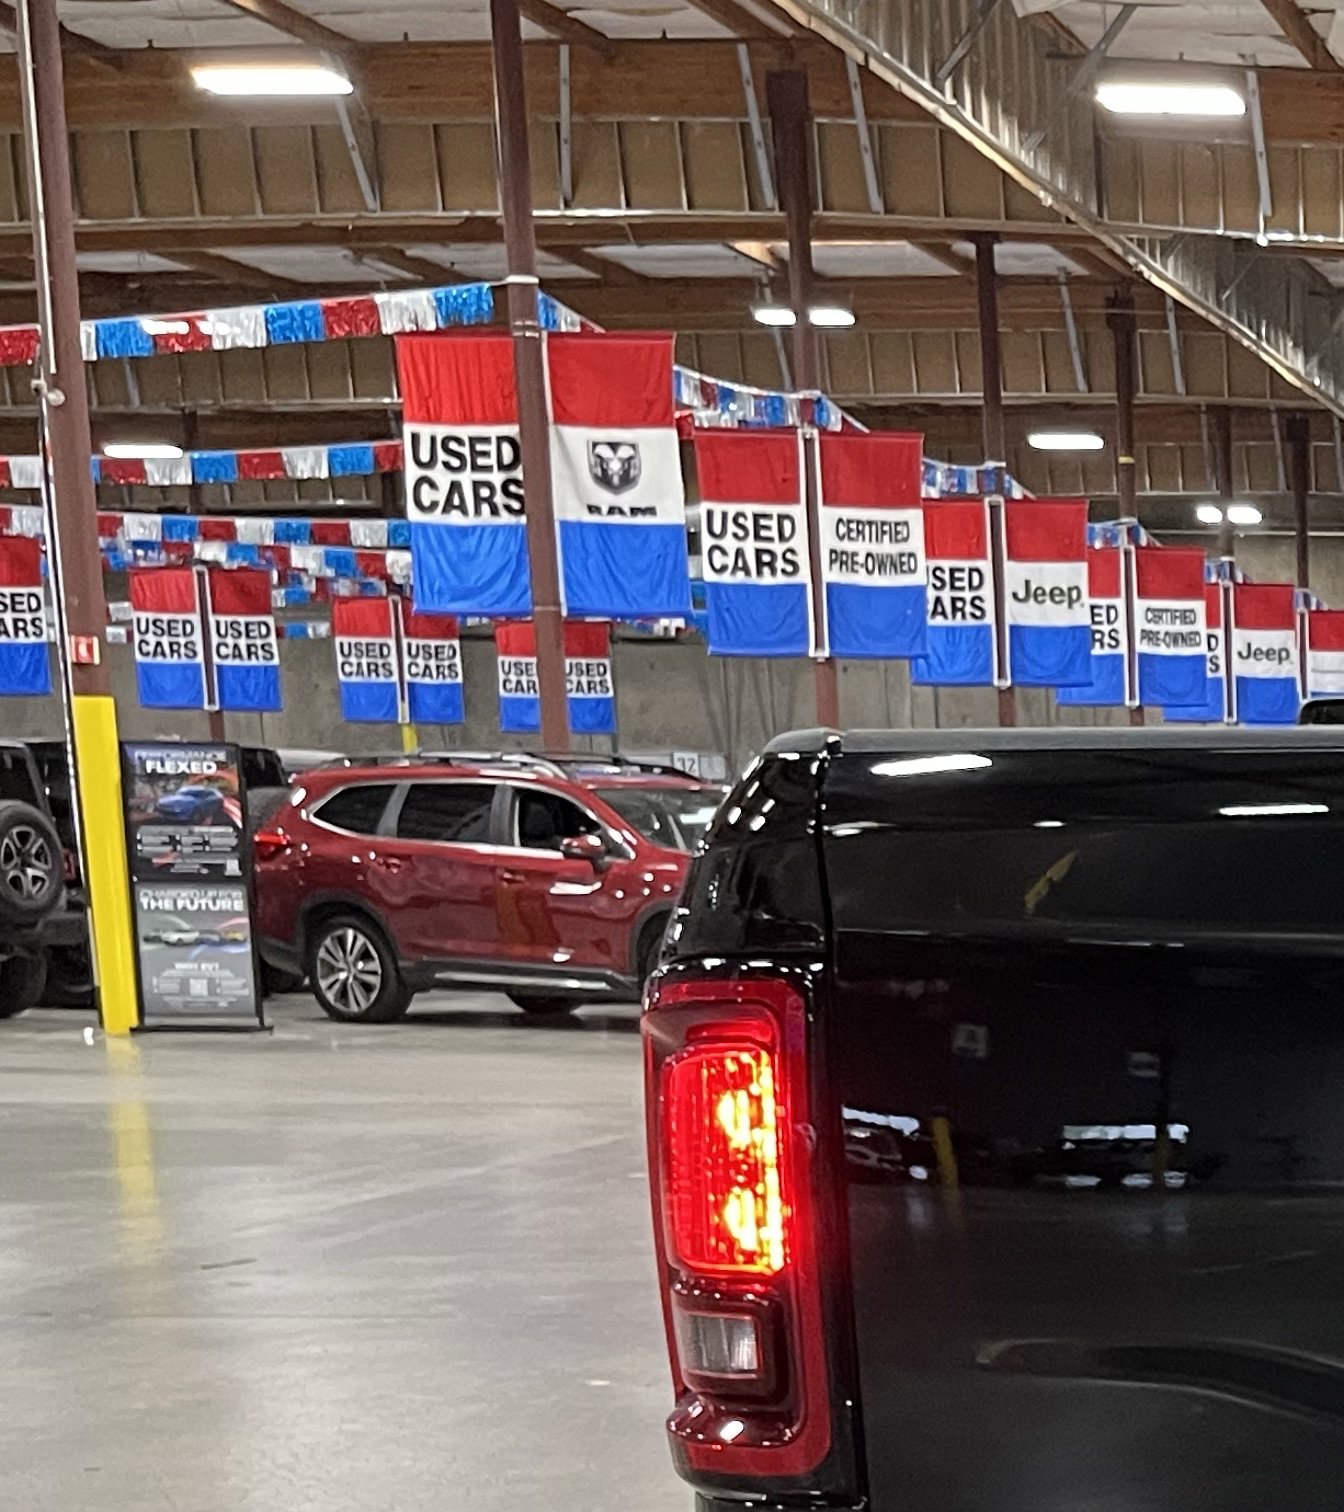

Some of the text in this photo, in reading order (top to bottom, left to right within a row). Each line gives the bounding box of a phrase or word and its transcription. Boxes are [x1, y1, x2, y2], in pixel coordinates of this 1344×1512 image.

[410, 432, 523, 474] USED
[412, 475, 526, 517] CARS
[586, 504, 658, 518] RAM
[706, 509, 797, 543] USED
[835, 518, 911, 544] CERTIFIED
[707, 545, 800, 578] CARS
[829, 549, 918, 576] PRE-OWNED
[926, 566, 985, 591] SED
[0, 592, 41, 613] SED
[1012, 579, 1082, 609] Jeep
[930, 596, 987, 620] ARS
[1144, 607, 1197, 625] CERTIFIED
[0, 617, 43, 638] ARS
[136, 618, 195, 638] USED
[215, 620, 271, 640] USED
[138, 639, 199, 659] CARS
[1140, 629, 1202, 649] PRE-OWNED
[215, 642, 275, 662] CARS
[339, 641, 391, 659] USED
[407, 641, 457, 661] USED
[1237, 642, 1290, 665] Jeep
[340, 661, 393, 679] CARS
[407, 662, 459, 680] CARS
[501, 660, 535, 677] USE
[502, 678, 538, 694] CAR
[145, 759, 218, 774] FLEXED
[140, 898, 244, 912] THE FUTURE
